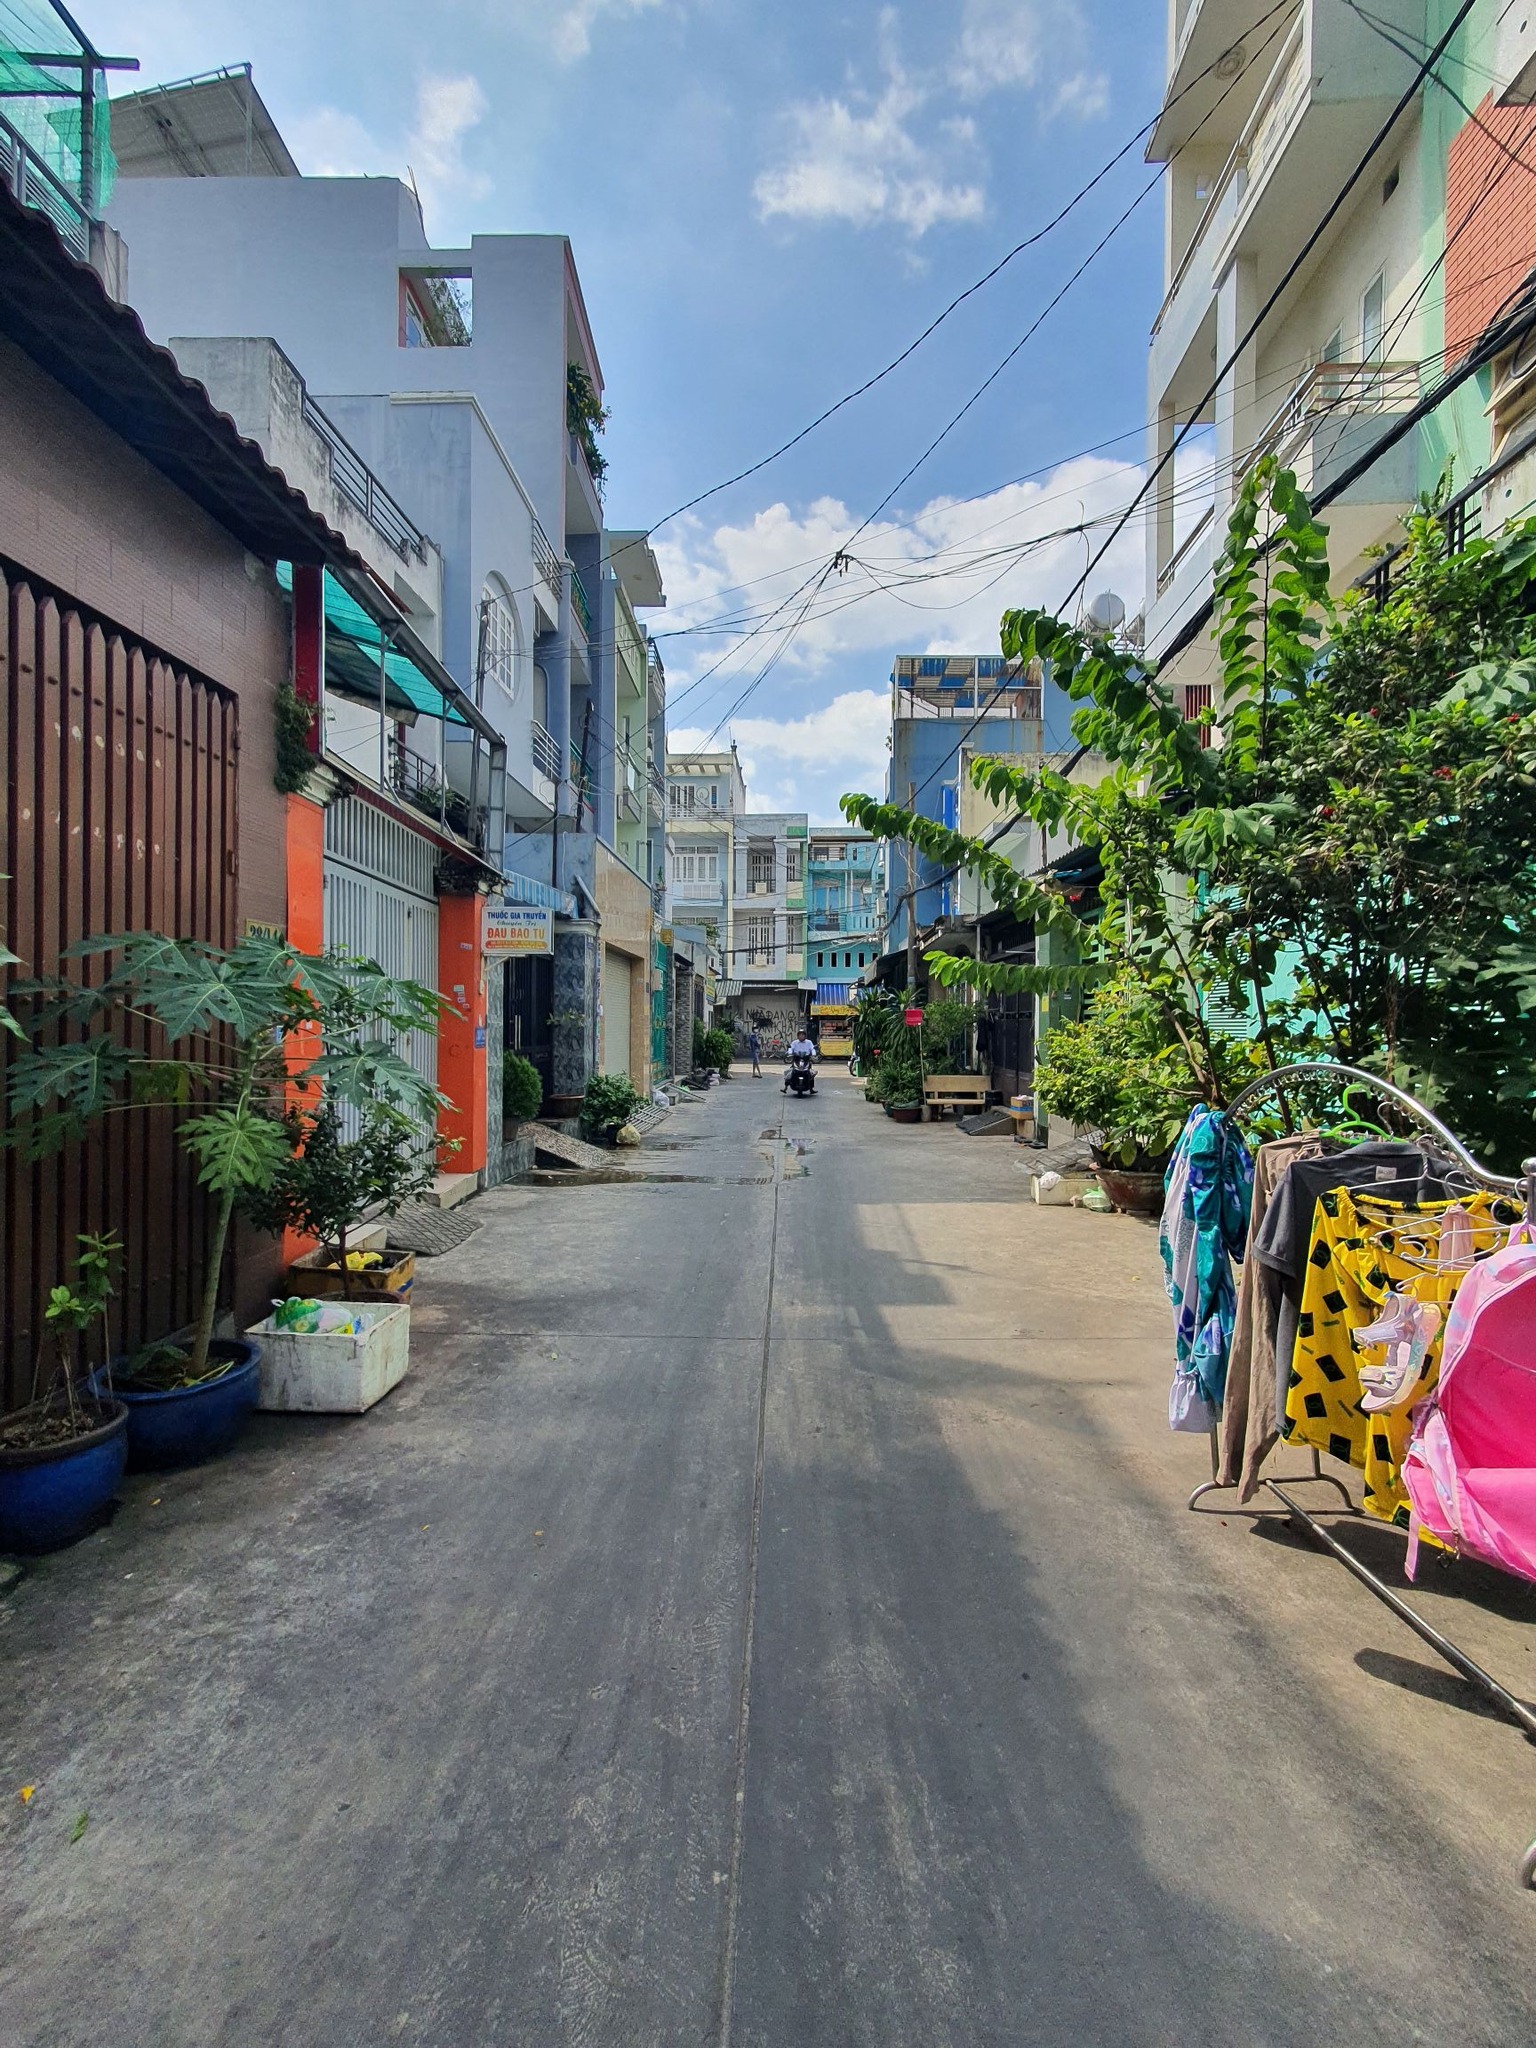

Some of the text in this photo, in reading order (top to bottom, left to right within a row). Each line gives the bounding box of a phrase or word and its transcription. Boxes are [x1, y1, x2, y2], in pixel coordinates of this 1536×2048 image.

[487, 911, 508, 919] THUỐC
[523, 911, 546, 920] TRUYỀN
[487, 927, 507, 938] ĐAU
[510, 927, 530, 938] BAO
